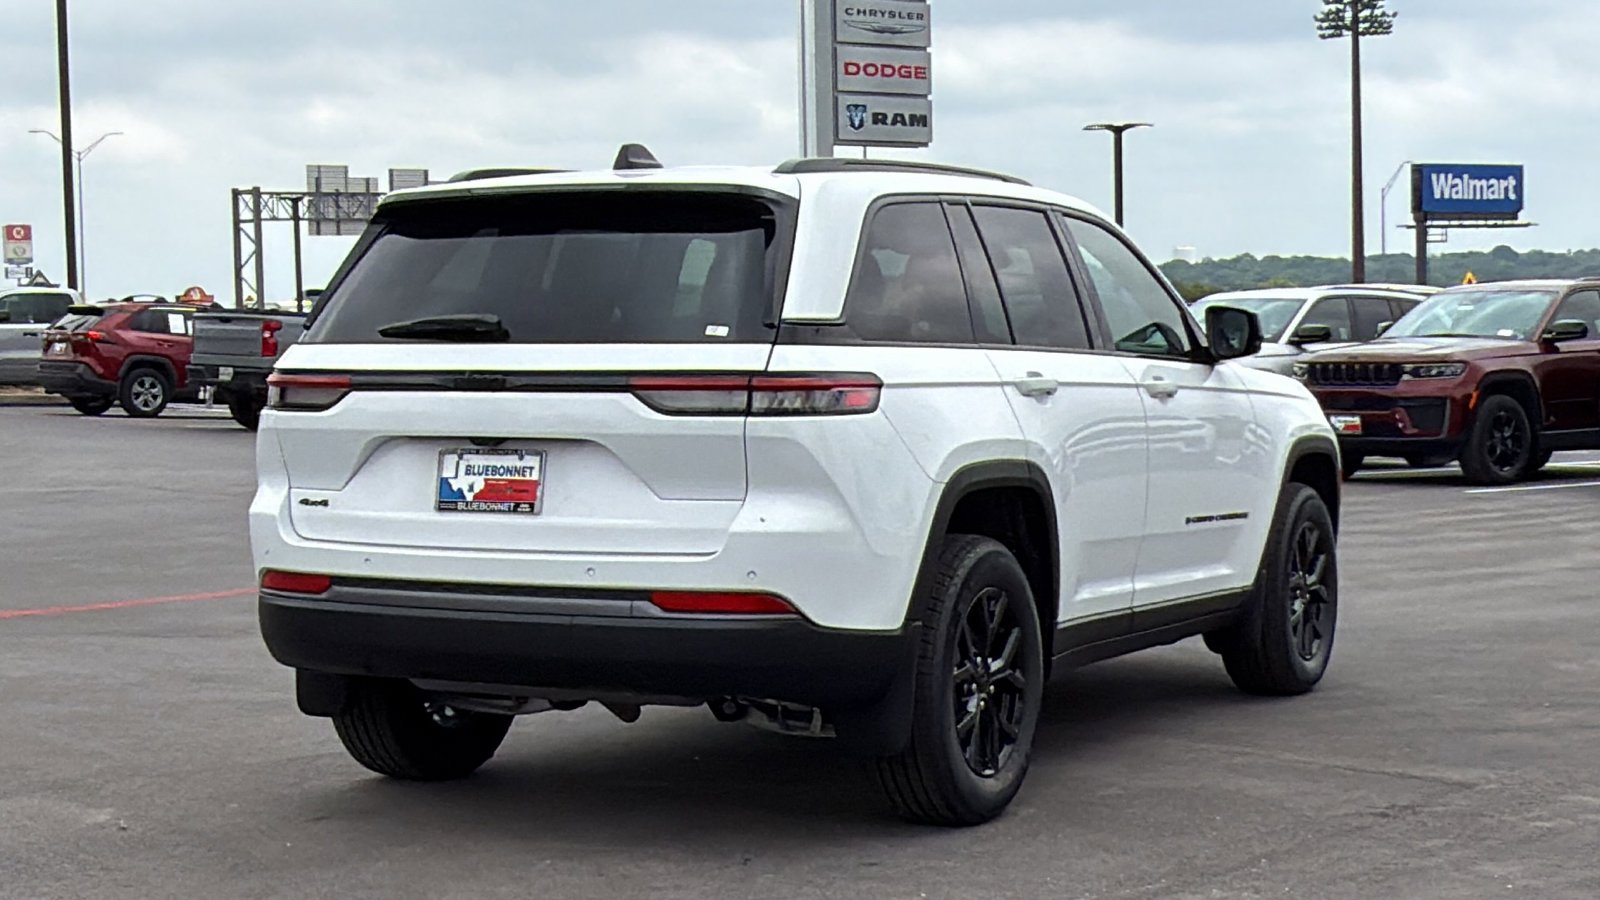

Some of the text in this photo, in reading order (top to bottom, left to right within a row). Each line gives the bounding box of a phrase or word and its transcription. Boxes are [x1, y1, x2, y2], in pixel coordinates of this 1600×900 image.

[844, 7, 925, 21] CHRYSLER
[843, 62, 928, 80] DODGE
[871, 111, 928, 128] RAM
[1430, 172, 1517, 200] Walmart
[464, 464, 535, 478] BLUEBONNET
[457, 502, 516, 511] BLUEBONNET
